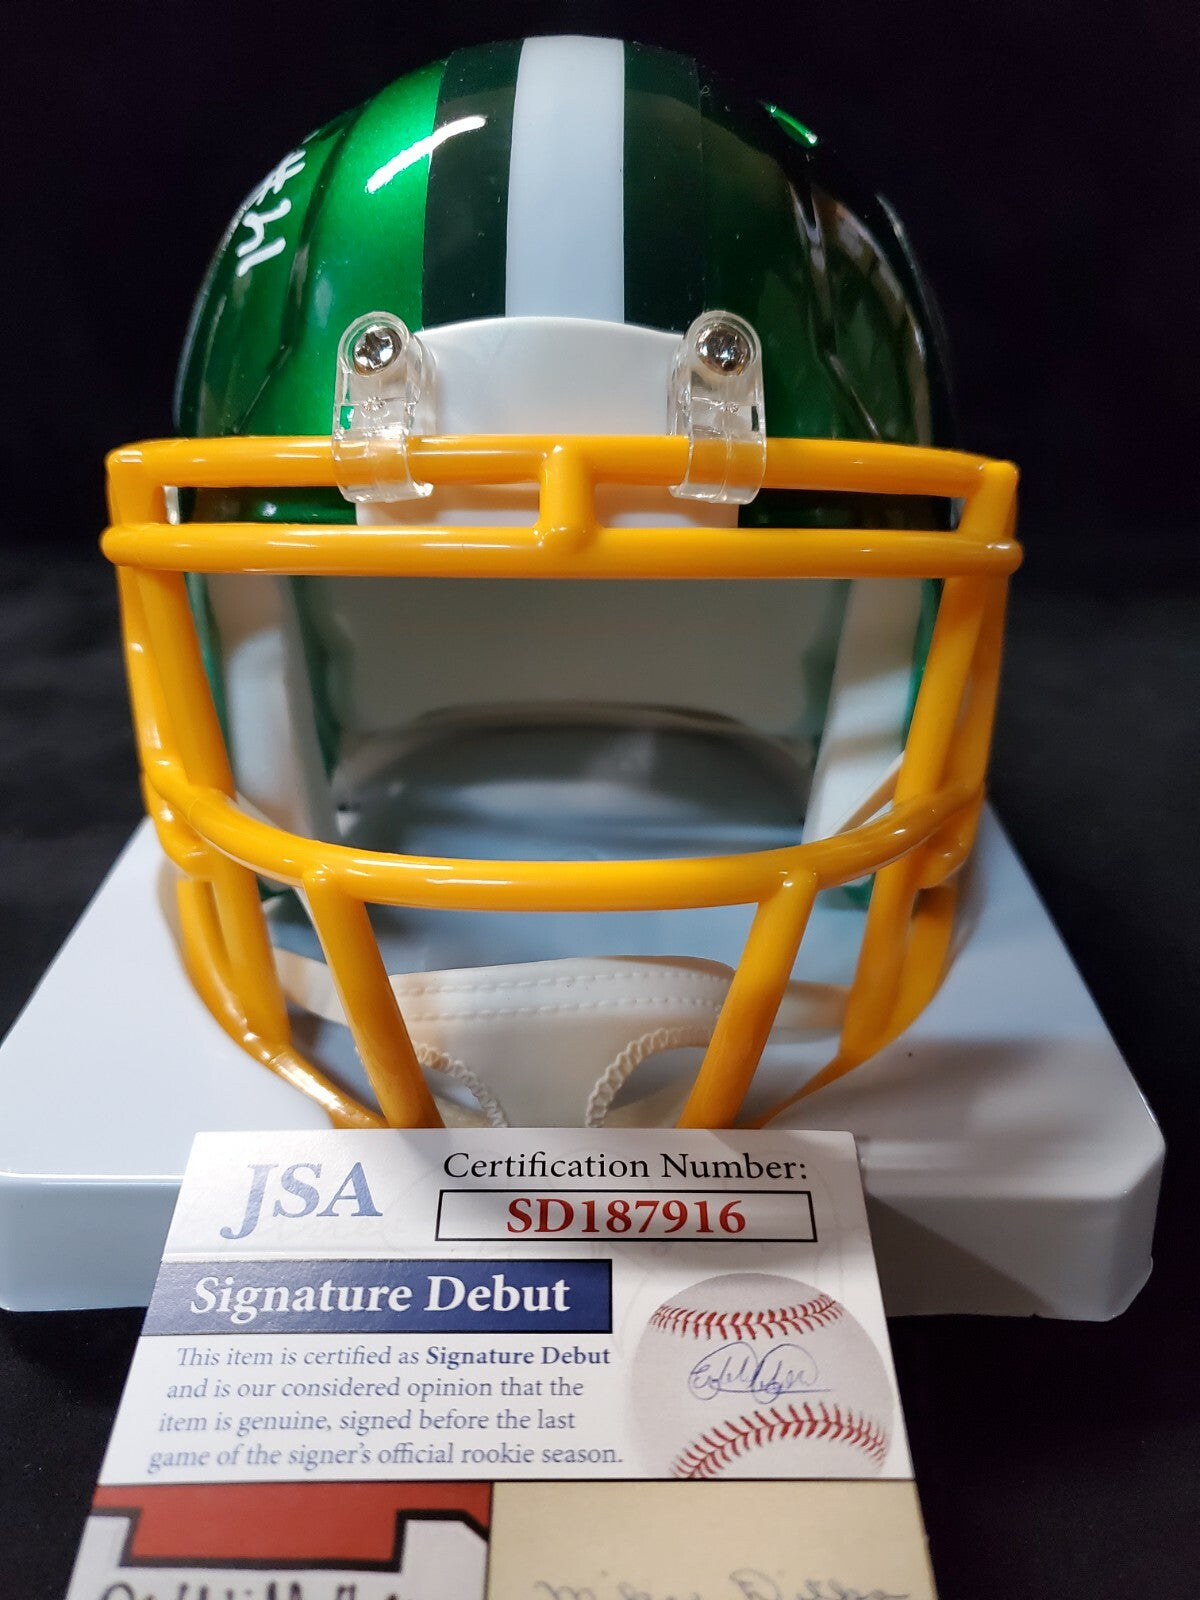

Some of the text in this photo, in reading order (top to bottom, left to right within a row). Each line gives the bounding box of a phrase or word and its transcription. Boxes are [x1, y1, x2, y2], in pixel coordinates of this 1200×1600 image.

[444, 1151, 807, 1180] Certification Number:
[219, 1161, 383, 1241] JSA
[507, 1198, 746, 1234] SD187916
[189, 1274, 571, 1325] Signature Debut
[177, 1345, 611, 1370] This item is certified as Signature Debut
[167, 1376, 585, 1403] and is our considered opinion that the
[158, 1408, 577, 1437] item is genuine, signed before the last
[147, 1451, 210, 1475] game
[216, 1444, 245, 1467] of
[247, 1443, 282, 1466] the
[377, 1442, 454, 1465] official
[460, 1441, 535, 1464] rookie
[541, 1448, 624, 1464] season.
